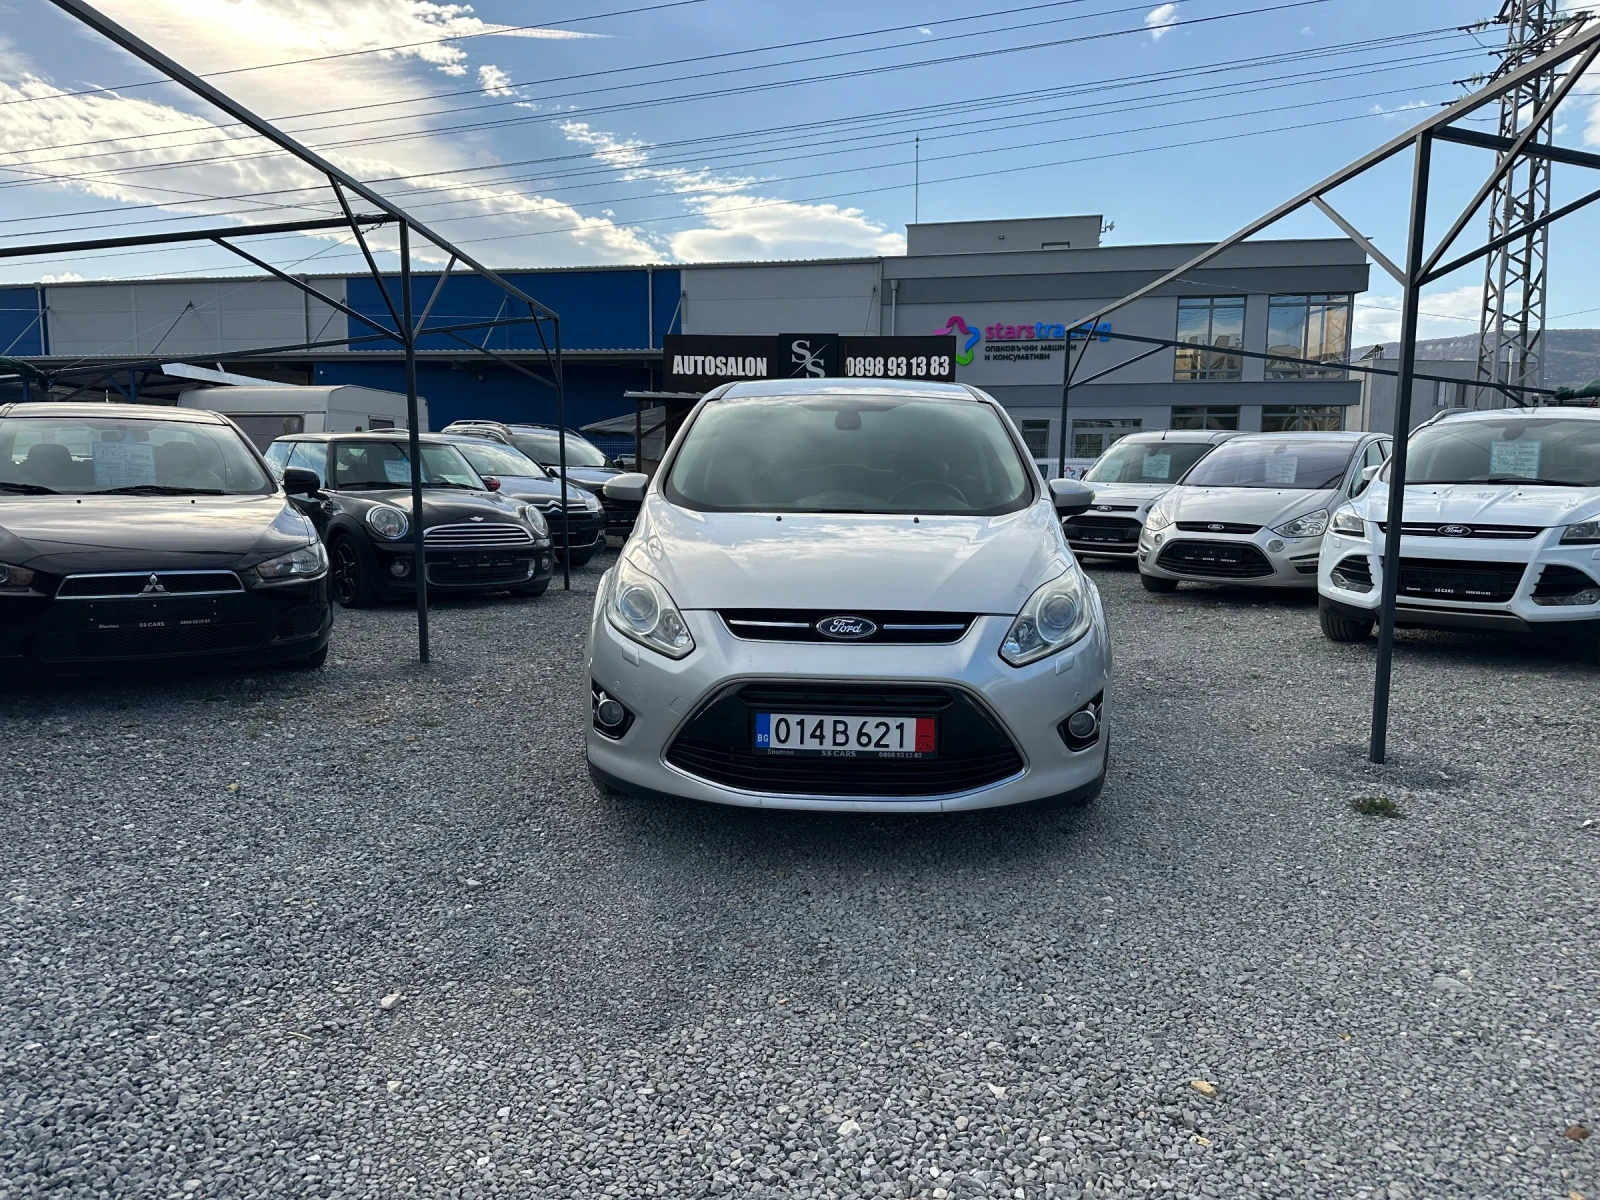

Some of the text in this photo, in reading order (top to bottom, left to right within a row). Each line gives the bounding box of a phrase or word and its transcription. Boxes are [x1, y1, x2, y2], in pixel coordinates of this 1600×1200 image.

[985, 319, 1112, 342] starstrag
[985, 344, 1077, 353] опаковъчни машии
[984, 353, 1051, 362] и консумативи
[672, 355, 768, 377] AUTOSALON
[845, 355, 950, 377] 0898 93 13 83
[829, 619, 863, 633] Ford
[757, 734, 769, 743] BG
